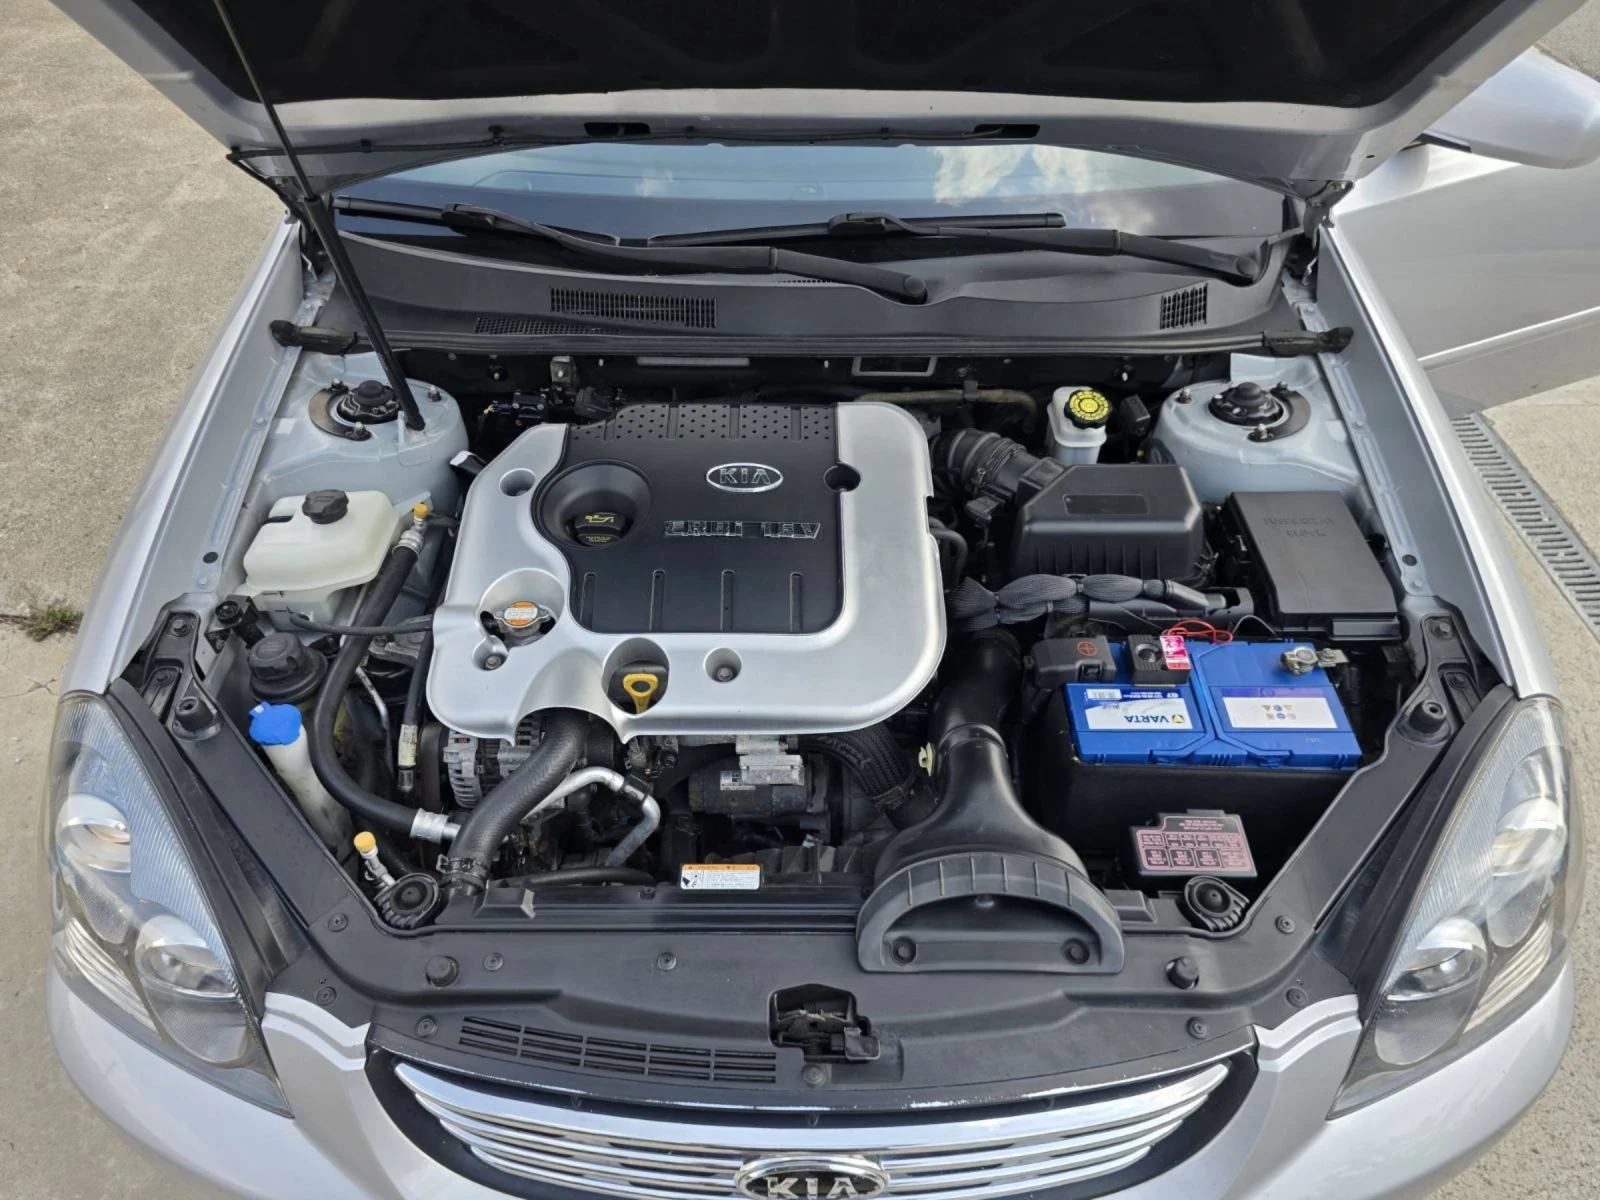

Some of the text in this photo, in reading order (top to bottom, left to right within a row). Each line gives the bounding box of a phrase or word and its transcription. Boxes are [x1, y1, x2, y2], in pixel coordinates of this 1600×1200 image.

[719, 468, 771, 484] KIA
[761, 522, 821, 540] 16V
[1124, 714, 1170, 723] VARTA
[765, 1177, 860, 1200] KIA
